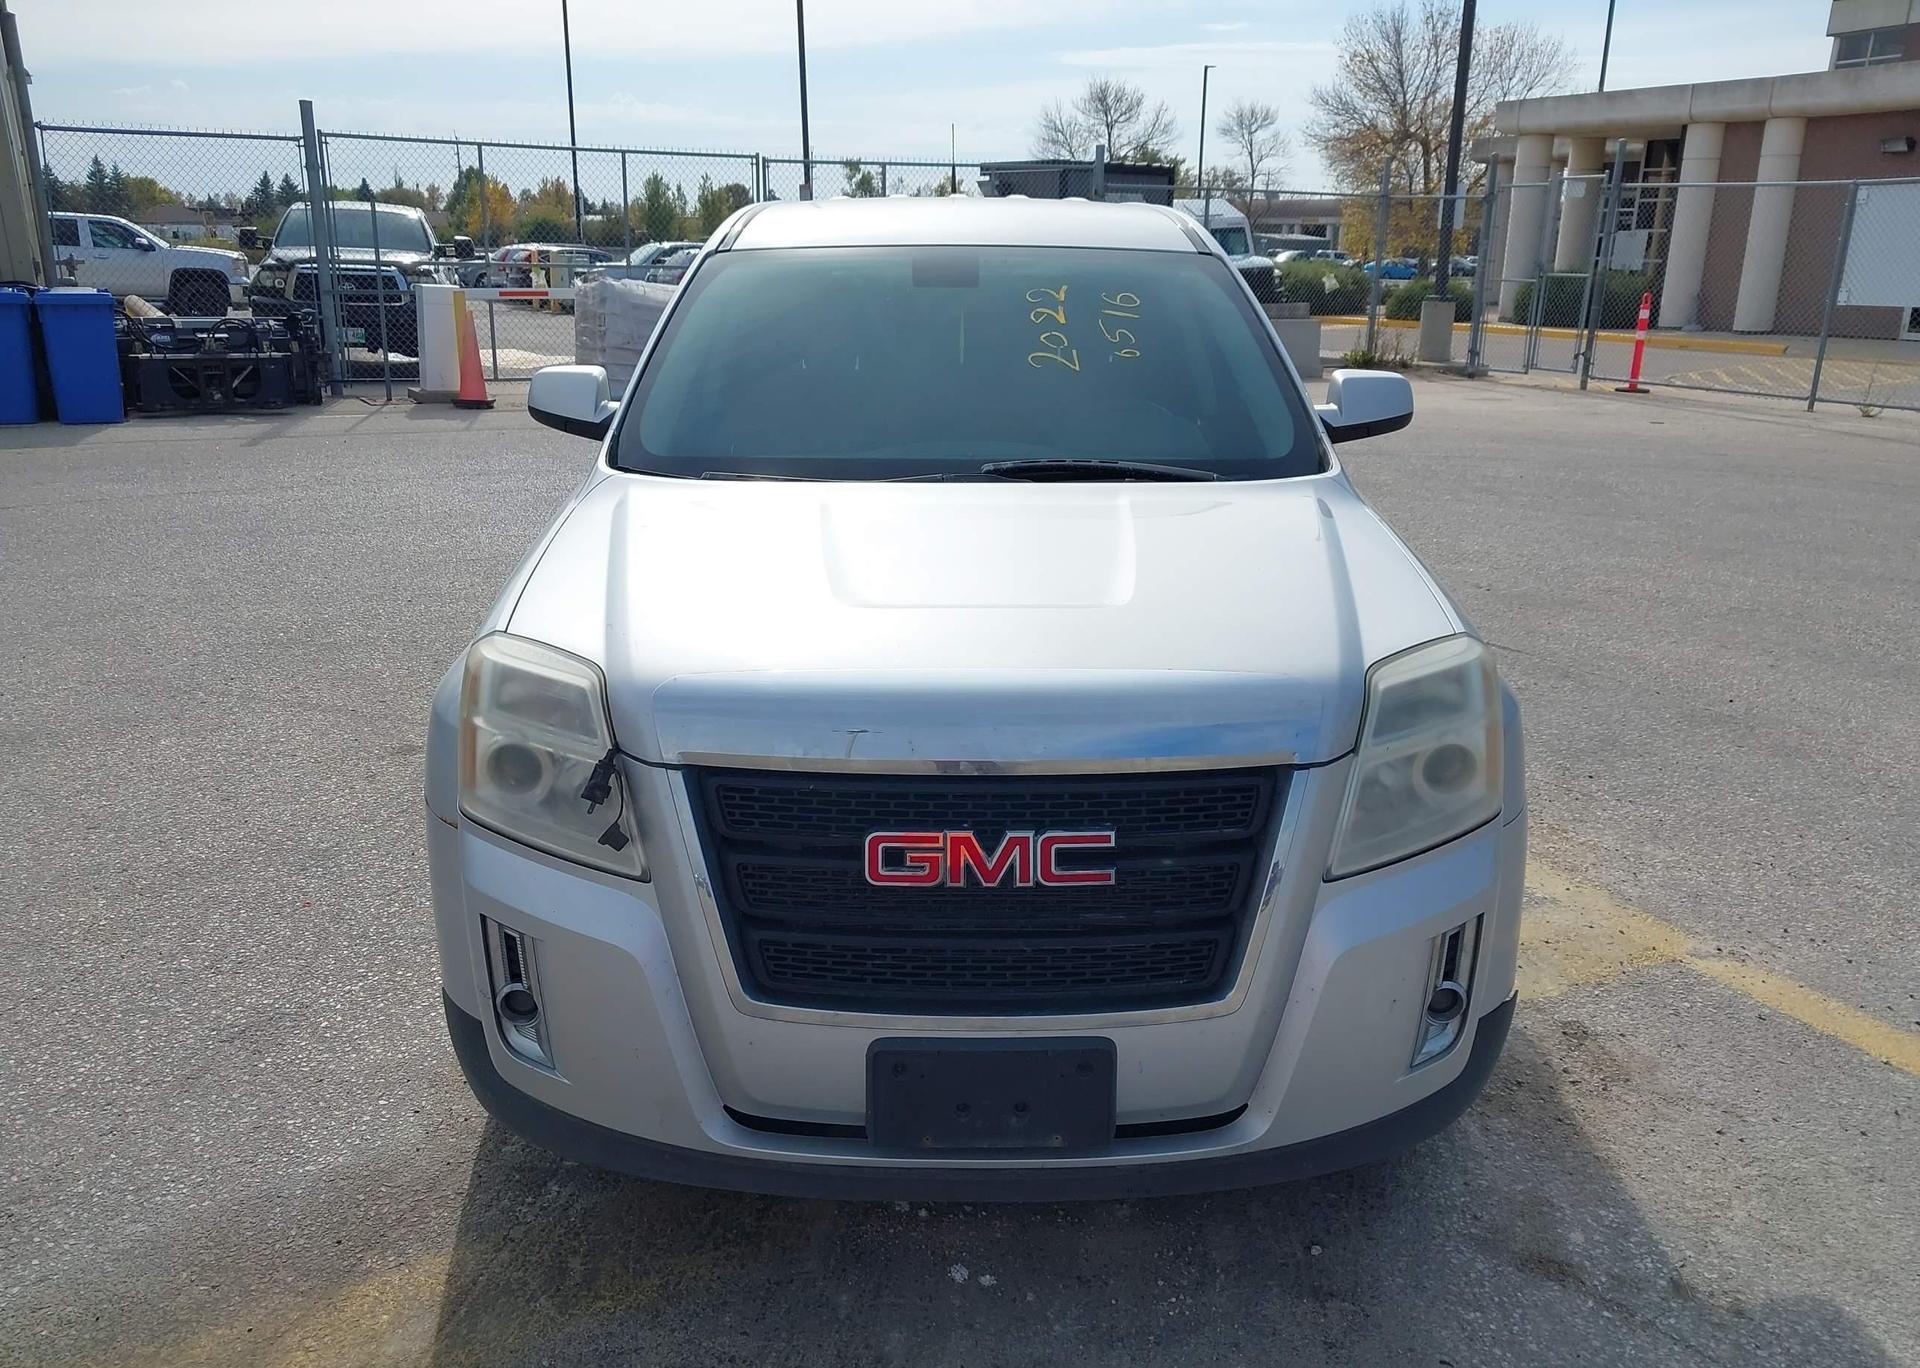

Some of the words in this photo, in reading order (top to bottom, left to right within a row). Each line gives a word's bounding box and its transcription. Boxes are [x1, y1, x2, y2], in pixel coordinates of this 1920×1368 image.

[1026, 285, 1080, 371] 2022
[1099, 292, 1140, 358] 6516
[864, 830, 1116, 887] GMC
